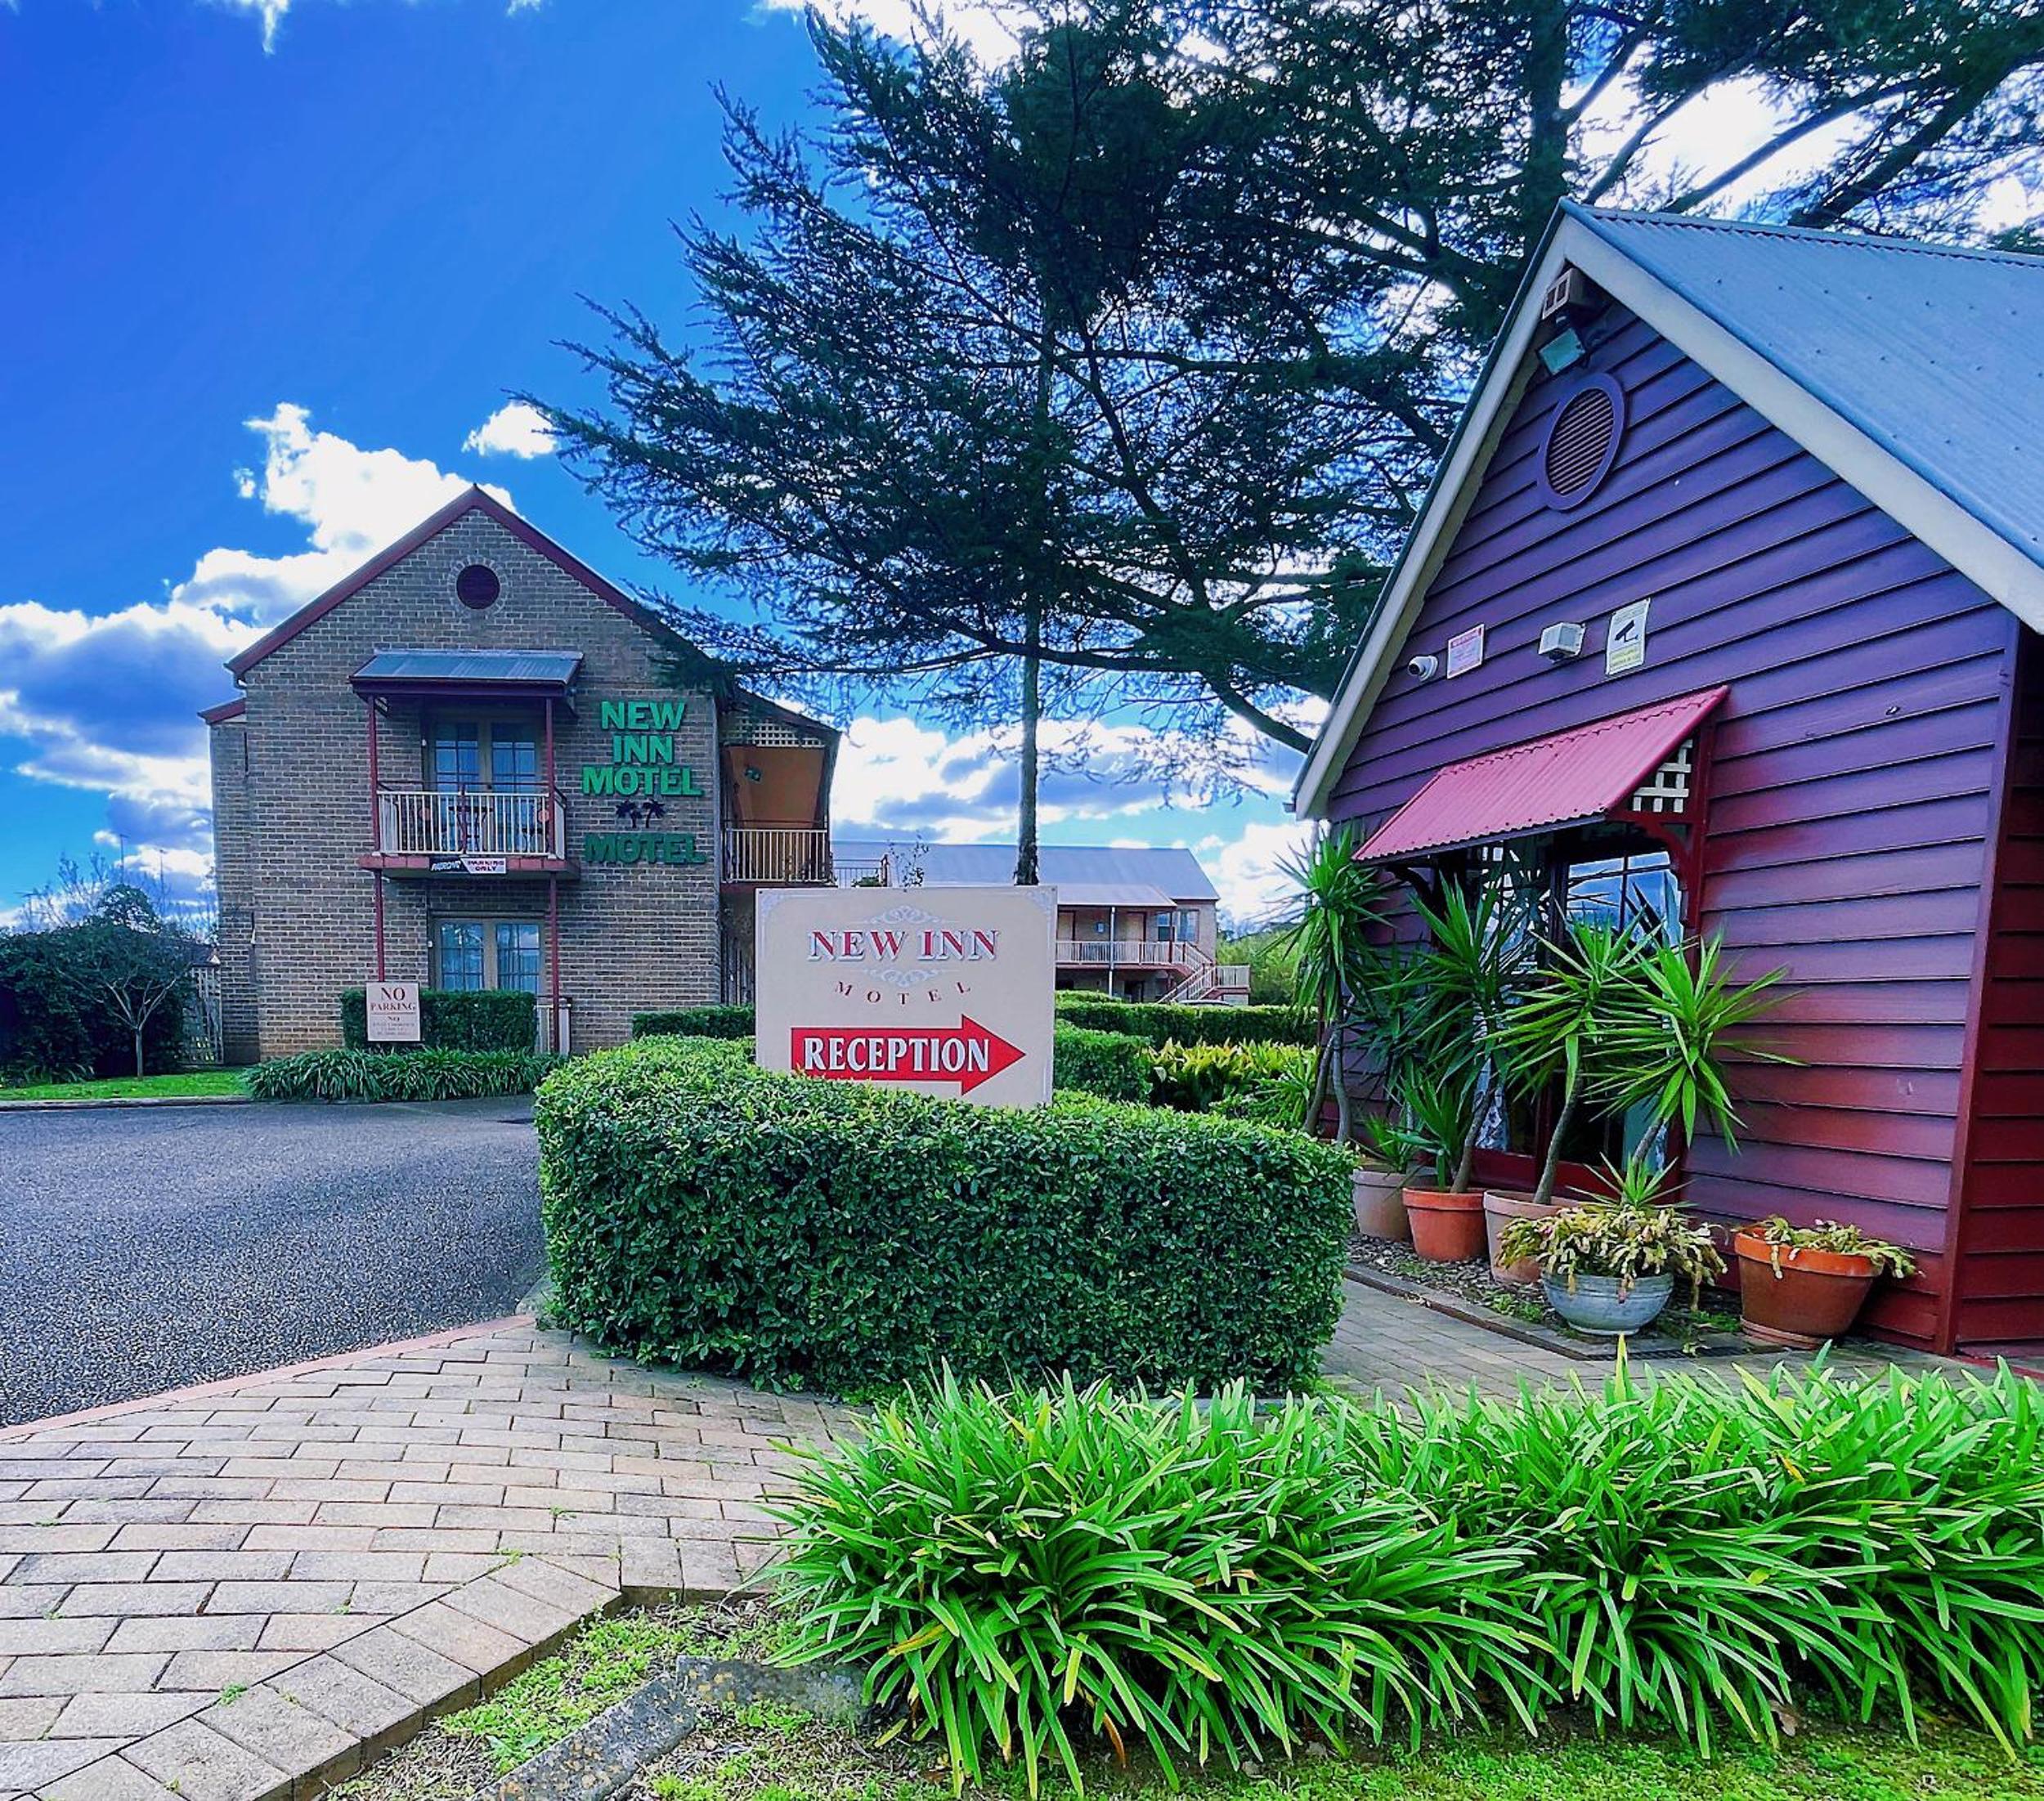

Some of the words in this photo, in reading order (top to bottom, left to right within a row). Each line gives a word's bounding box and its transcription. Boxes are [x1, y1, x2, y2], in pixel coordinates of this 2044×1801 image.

[601, 701, 684, 731] NEW
[612, 735, 673, 764] INN
[581, 766, 704, 796] MOTEL
[584, 833, 706, 864] MOTEL
[808, 930, 908, 961] NEW
[917, 930, 998, 961] INN
[371, 1002, 415, 1010] PARKING
[381, 988, 405, 1001] NO
[834, 981, 971, 1006] MOTEL
[804, 1037, 990, 1073] RECEPTION
